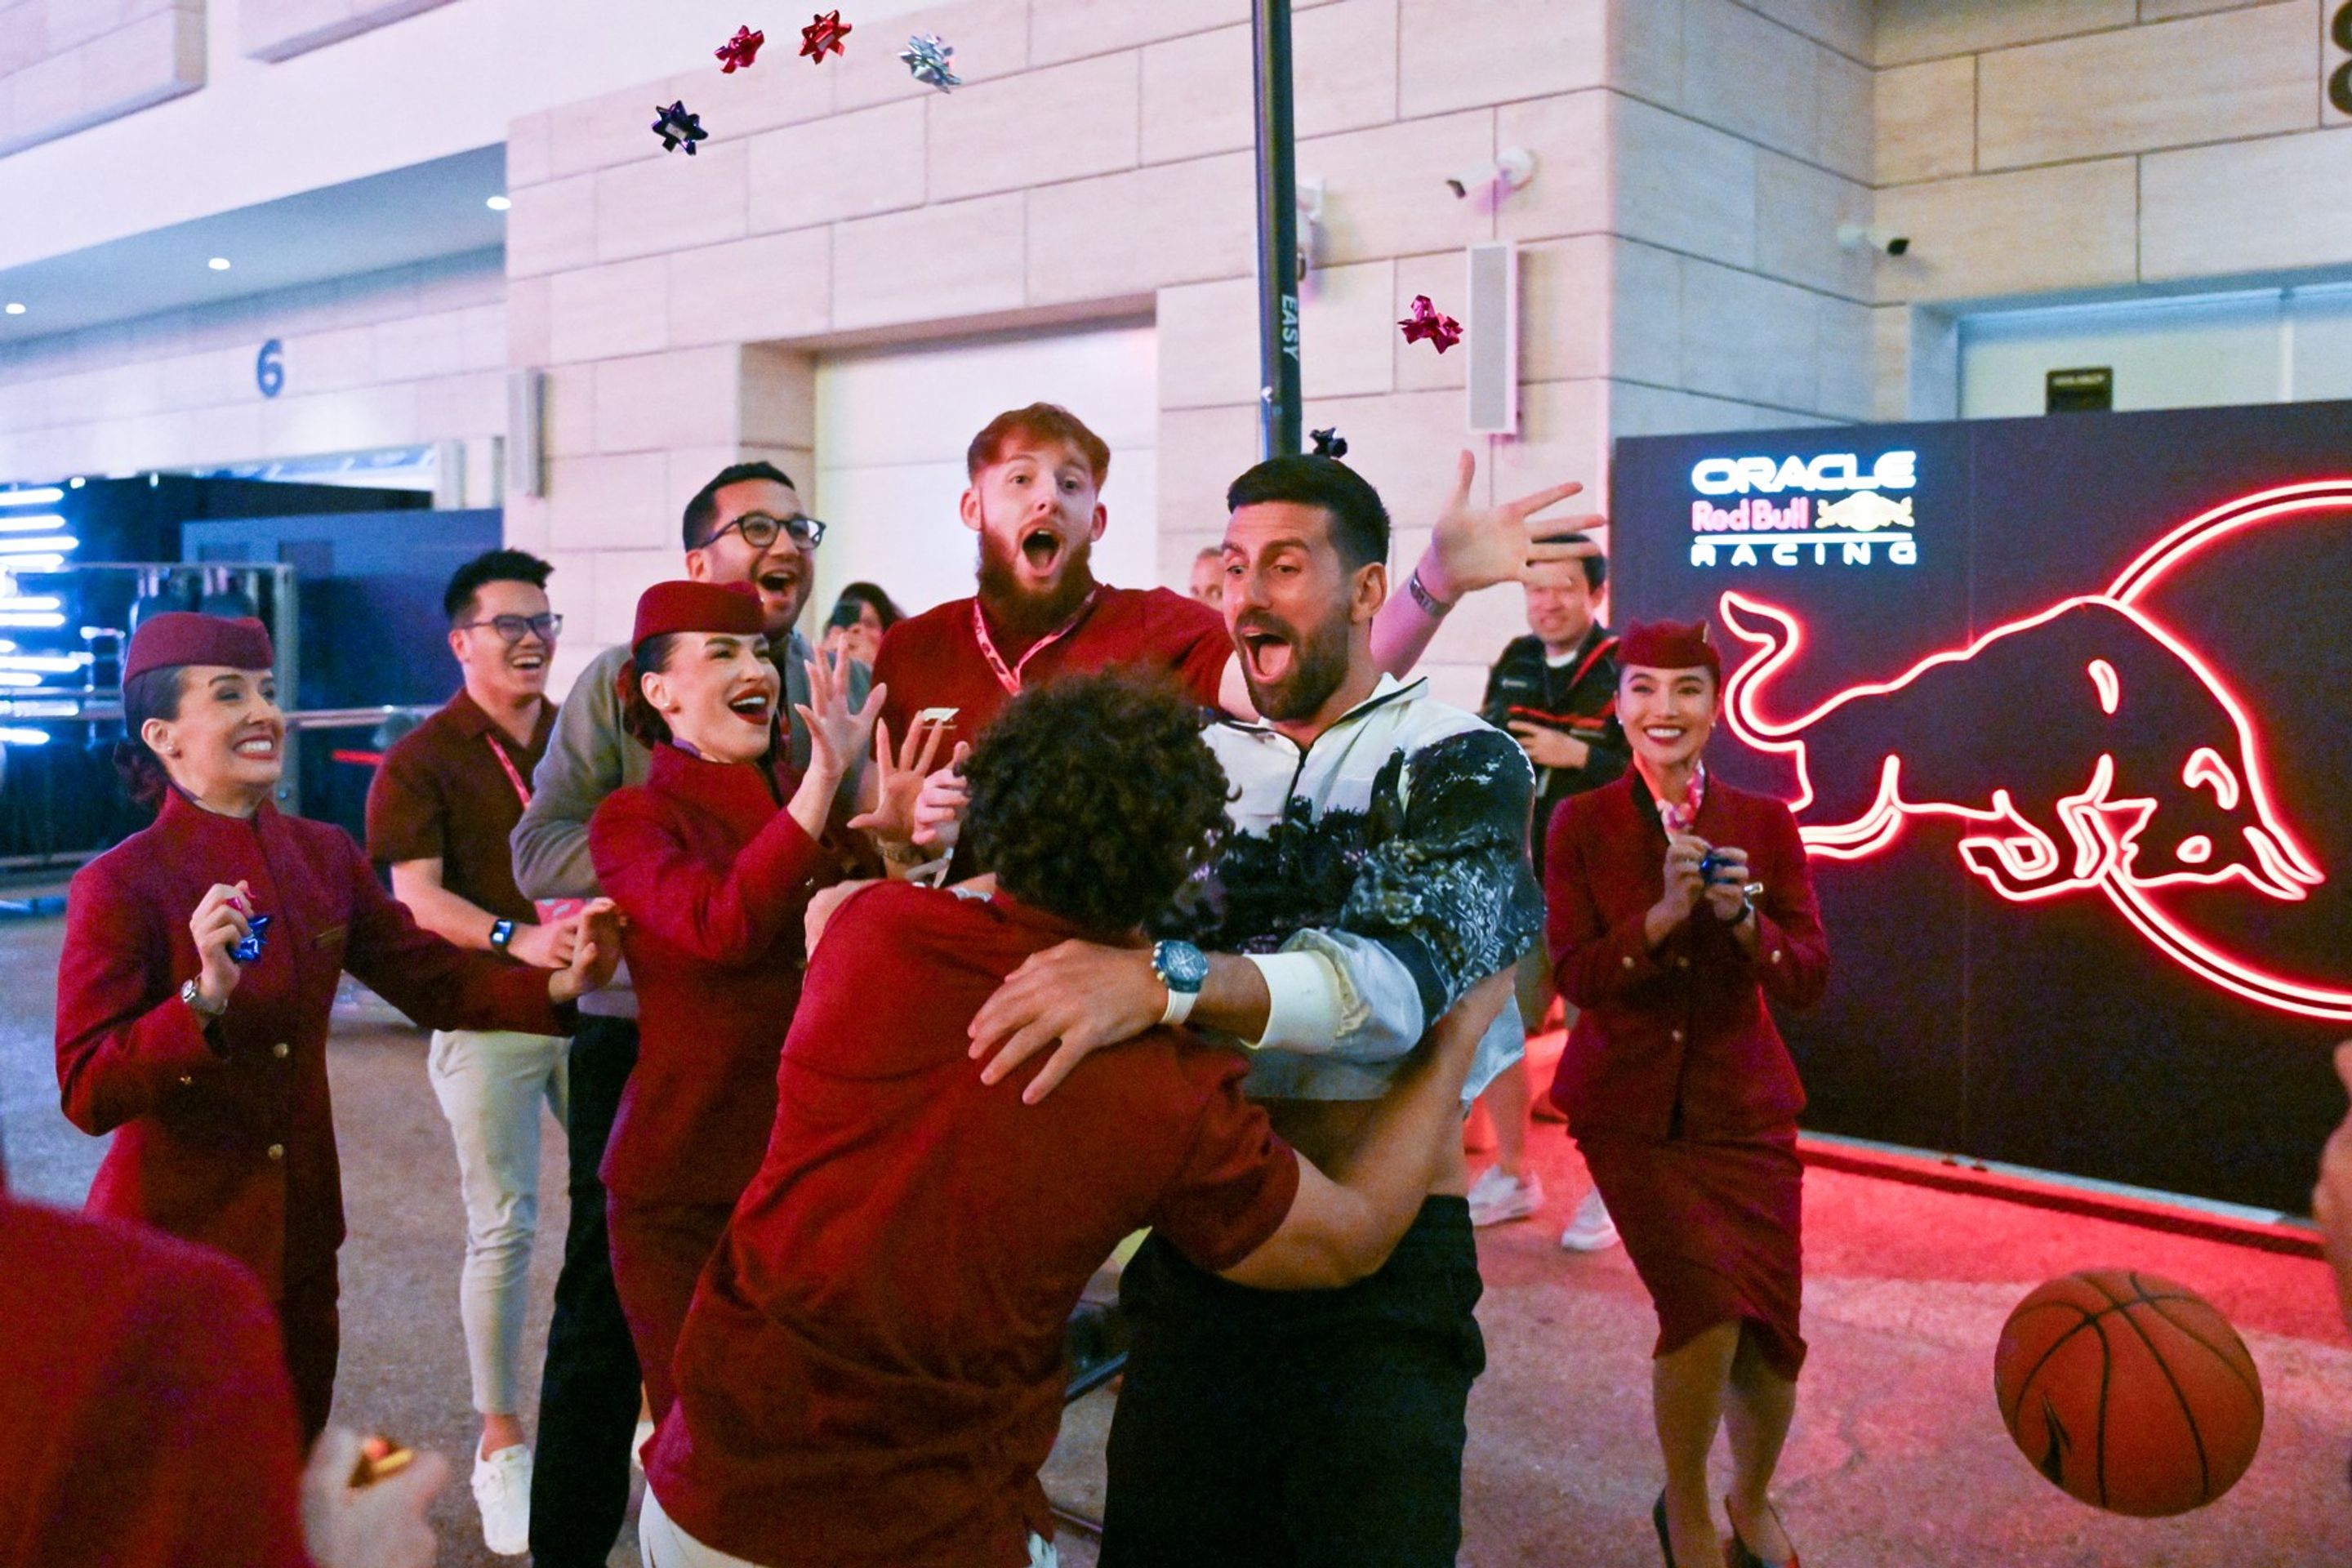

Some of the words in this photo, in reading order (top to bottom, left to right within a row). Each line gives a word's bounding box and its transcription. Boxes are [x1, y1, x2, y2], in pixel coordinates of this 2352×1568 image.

[1281, 293, 1298, 362] EASY
[256, 338, 283, 399] 6
[1691, 451, 1917, 495] ORACLE
[1690, 541, 1918, 567] RACING
